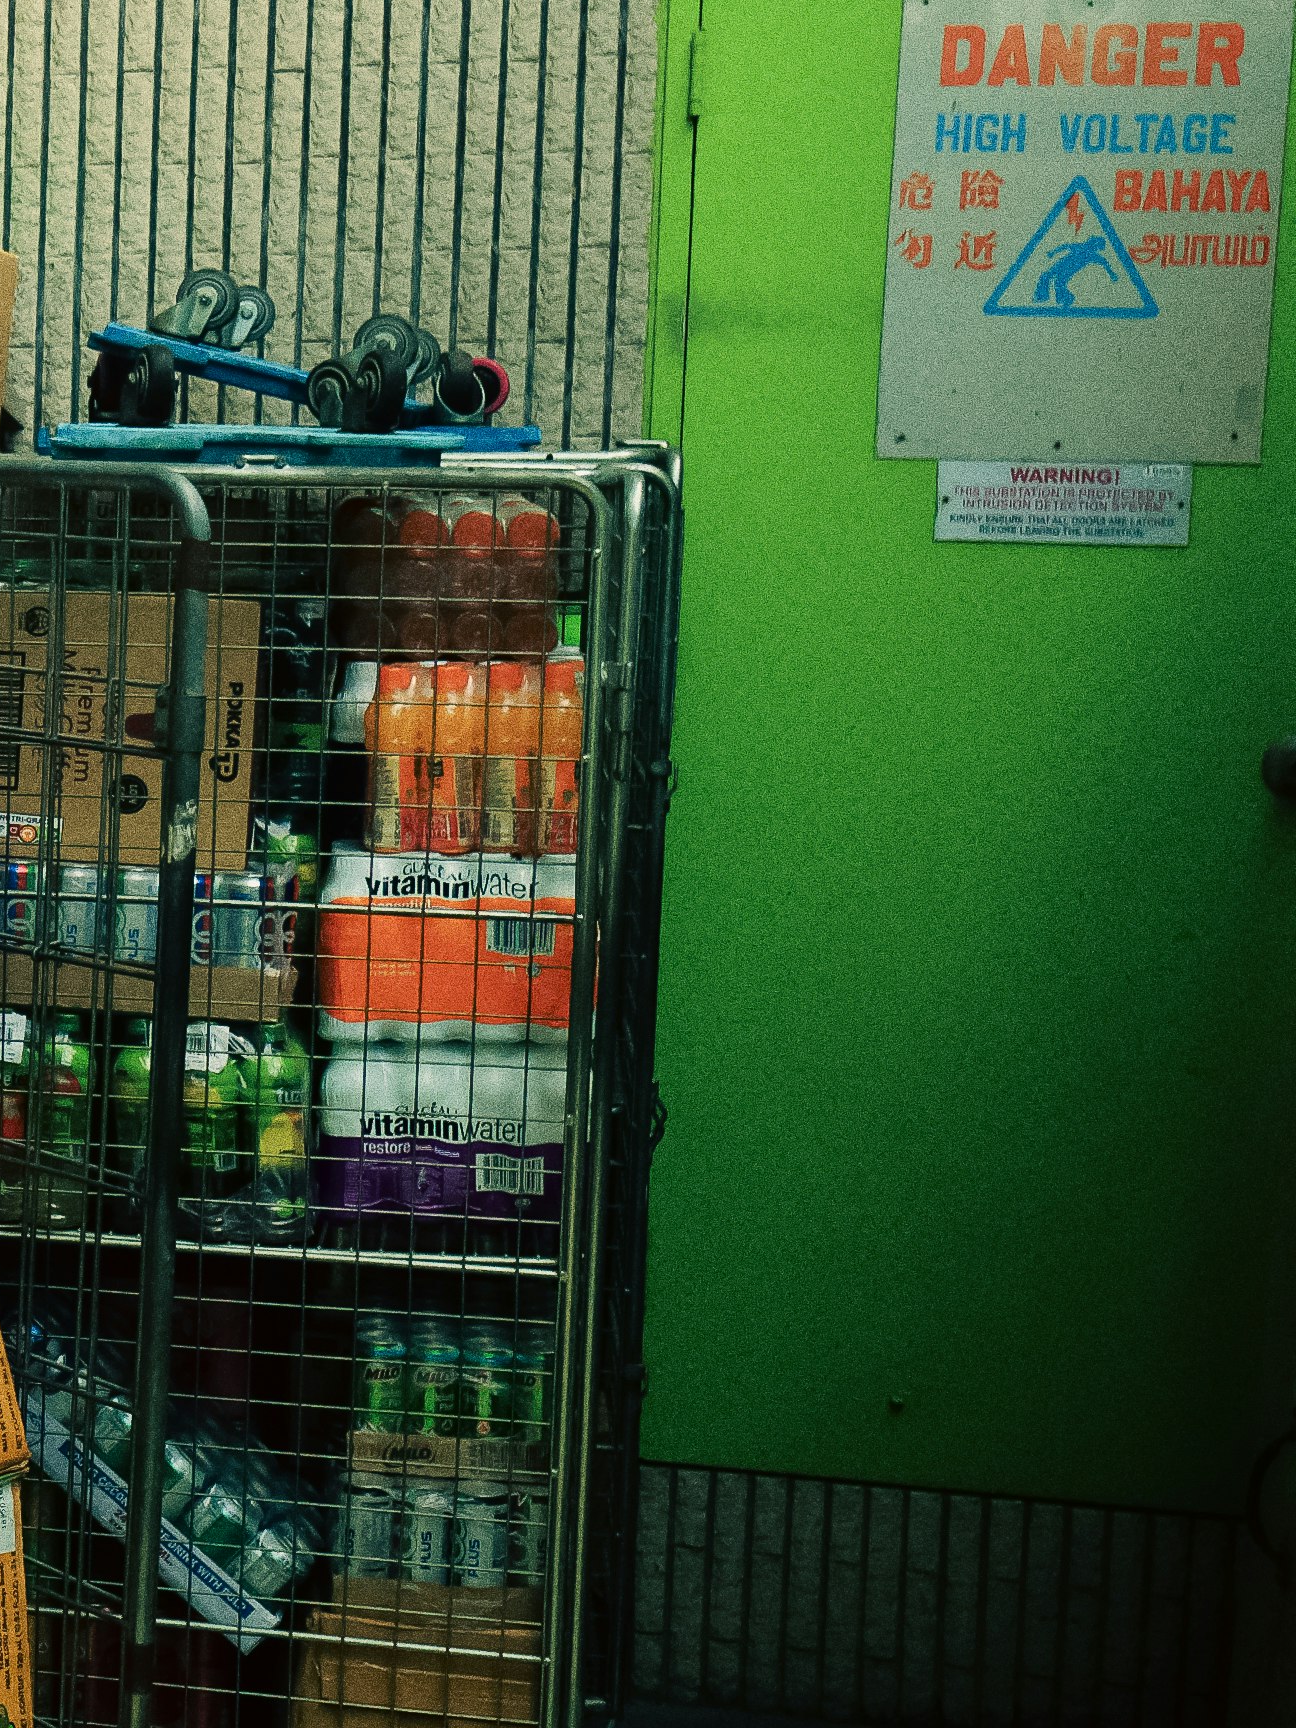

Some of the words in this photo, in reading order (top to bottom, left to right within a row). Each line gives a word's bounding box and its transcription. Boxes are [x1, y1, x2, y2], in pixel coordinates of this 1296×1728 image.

[939, 21, 1245, 88] DANGER
[935, 113, 1027, 154] HIGH
[1060, 114, 1236, 155] VOLTAGE
[1114, 170, 1270, 211] BAHAYA
[1011, 468, 1120, 485] WARNING!
[962, 499, 1028, 511] INTRUSION
[1035, 500, 1107, 512] DETECTION
[74, 667, 102, 783] Premum
[226, 682, 244, 748] POKKA
[365, 873, 540, 899] vitaminwater
[360, 1112, 527, 1144] vitaminwater
[363, 1141, 411, 1155] restore
